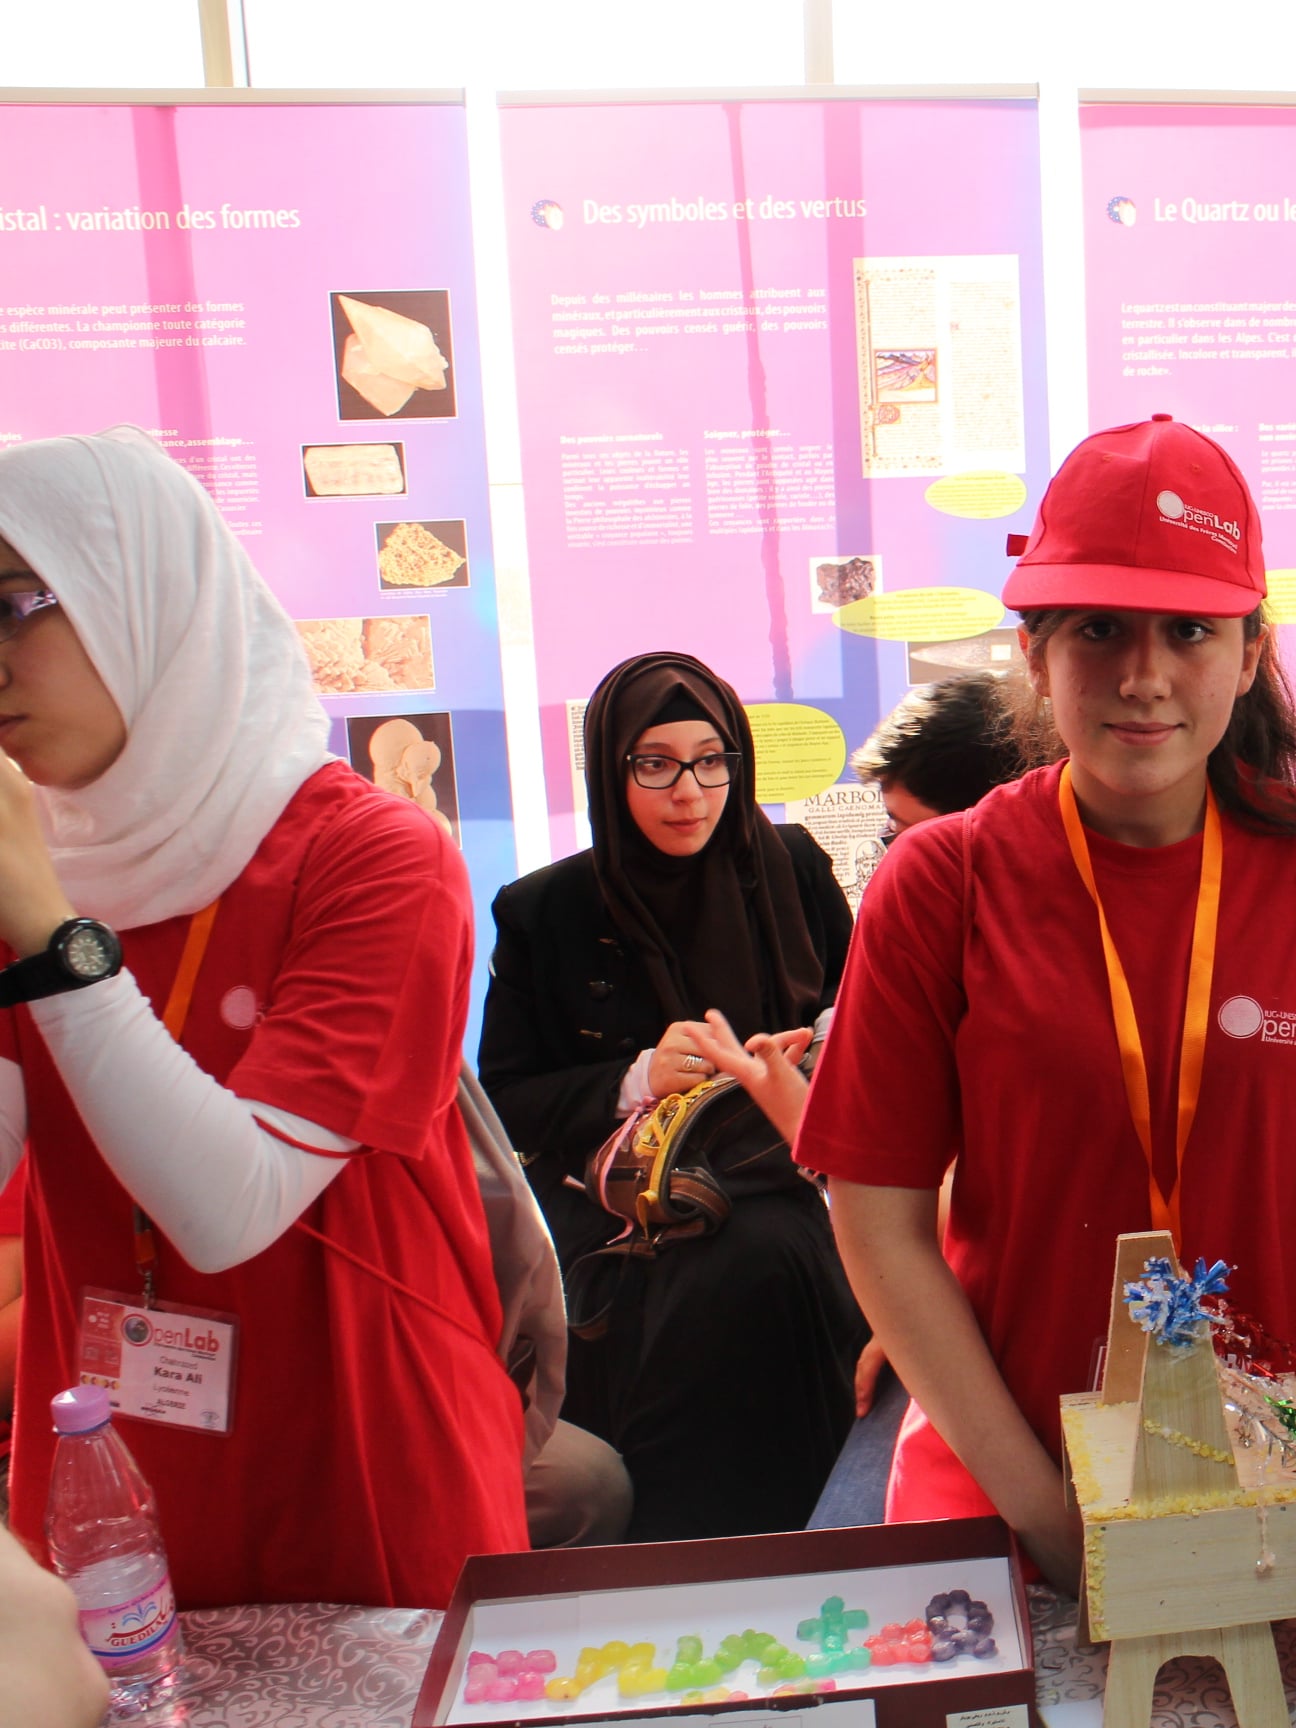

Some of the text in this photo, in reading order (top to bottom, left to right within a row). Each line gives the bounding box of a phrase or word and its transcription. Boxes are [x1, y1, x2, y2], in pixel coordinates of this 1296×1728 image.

[68, 205, 169, 230] variation
[177, 205, 214, 229] des
[221, 203, 301, 229] formes
[584, 195, 866, 227] Des symboles et des vertus
[1155, 199, 1176, 221] Le
[1182, 199, 1248, 223] Quartz
[1254, 205, 1279, 222] ou
[154, 1366, 183, 1381] Kara
